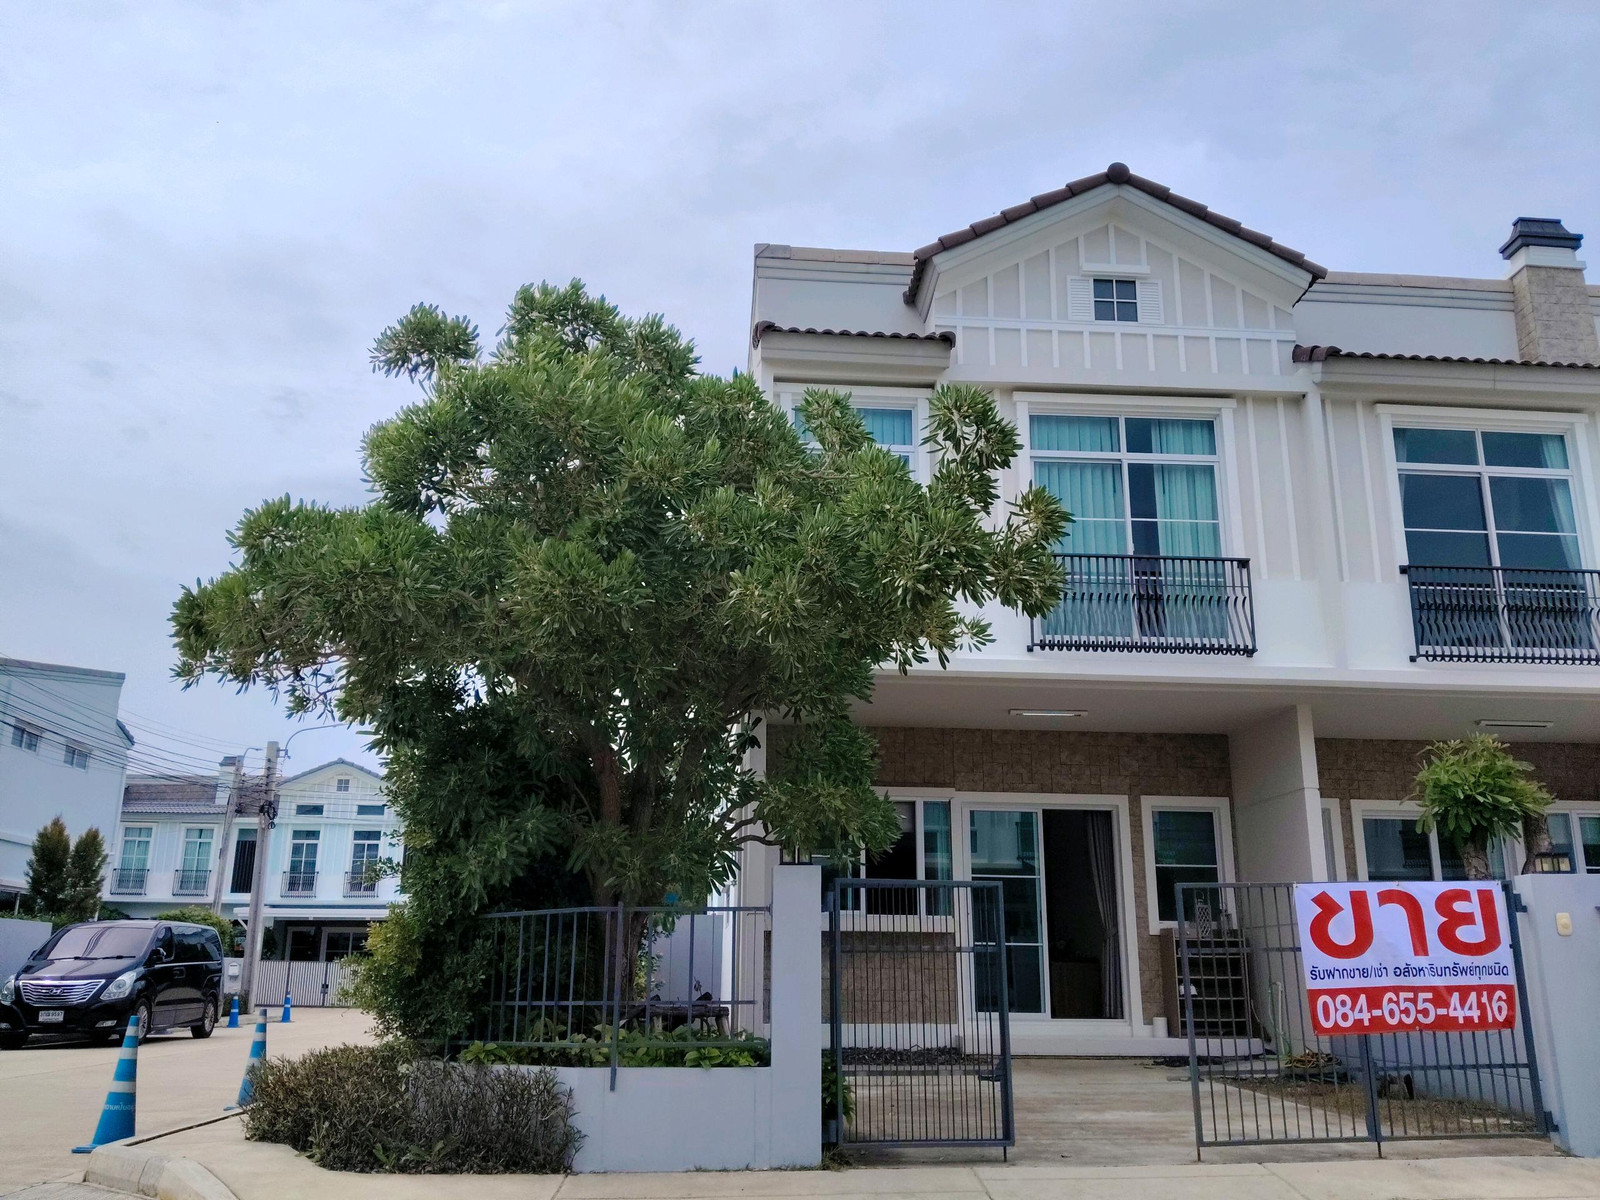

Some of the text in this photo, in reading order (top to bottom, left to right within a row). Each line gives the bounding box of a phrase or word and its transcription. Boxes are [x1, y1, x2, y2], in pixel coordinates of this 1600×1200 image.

[1309, 888, 1502, 960] ขาย
[1310, 961, 1509, 981] รับฝากขาย/เช่า อสังหาริมทรัพย์ทุกชนิด
[1317, 990, 1508, 1028] 084-655-4416
